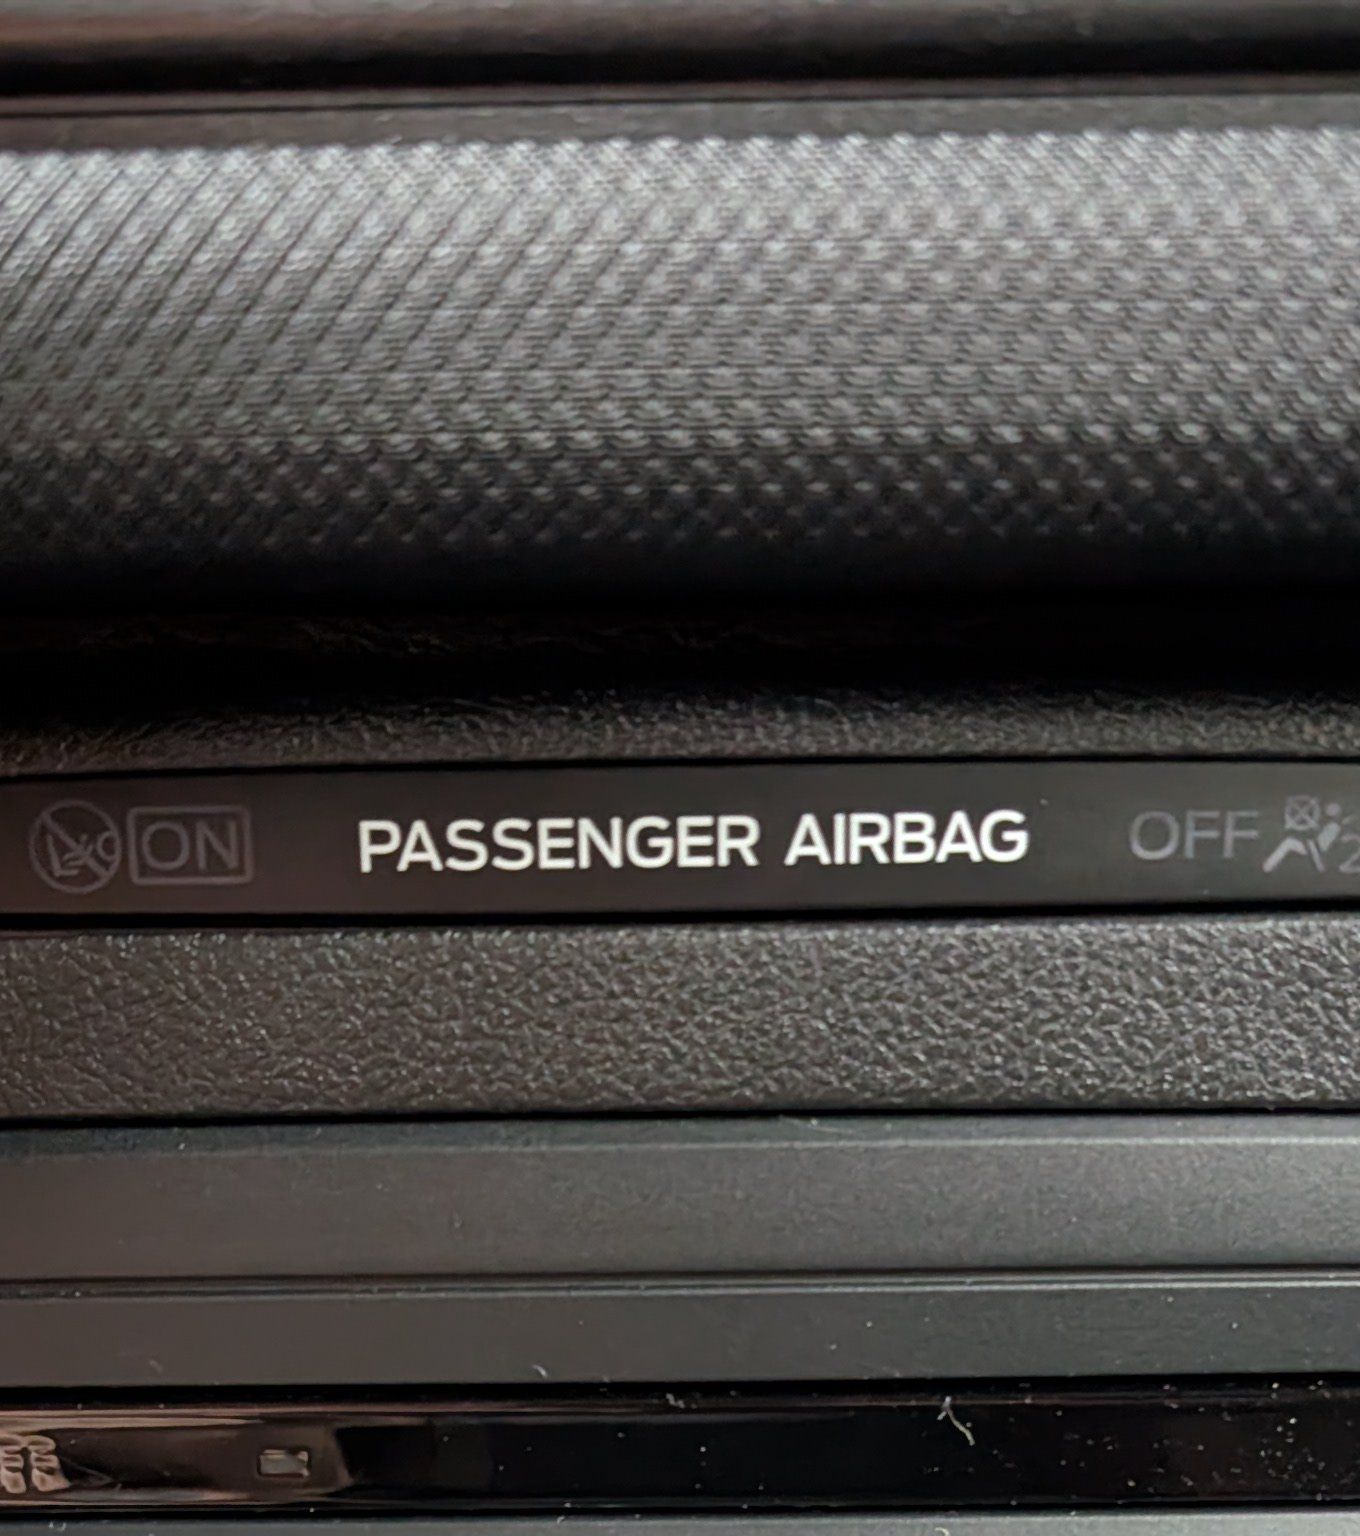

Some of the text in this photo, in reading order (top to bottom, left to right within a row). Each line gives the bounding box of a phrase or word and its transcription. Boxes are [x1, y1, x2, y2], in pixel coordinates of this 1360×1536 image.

[142, 820, 239, 871] ON
[358, 809, 1029, 873] PASSENGER AIRBAG
[1129, 810, 1260, 861] OFF
